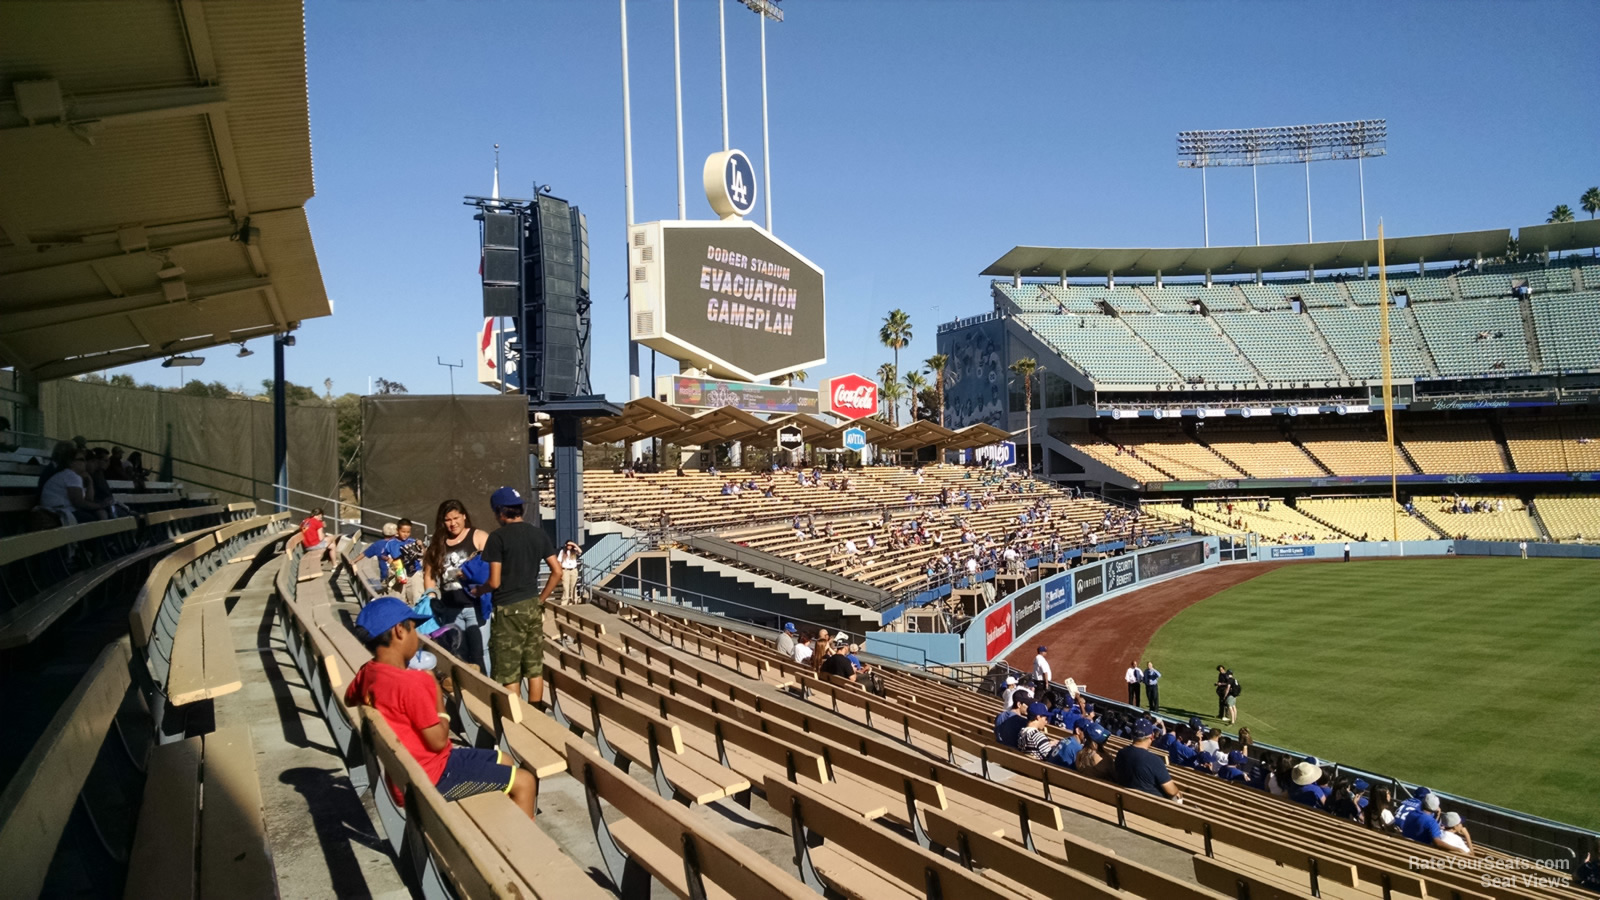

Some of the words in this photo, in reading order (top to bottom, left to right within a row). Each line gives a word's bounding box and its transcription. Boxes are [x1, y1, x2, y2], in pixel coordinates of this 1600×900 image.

[730, 158, 749, 205] LA
[707, 245, 748, 270] DODGER
[750, 257, 791, 281] STADIUM
[699, 264, 798, 311] EVACUATION
[706, 297, 794, 337] GAMEPLAN
[1155, 383, 1220, 391] DODGER
[1232, 382, 1310, 390] STADIUM
[1324, 380, 1367, 388] CLUB
[1446, 400, 1476, 410] Angeles
[1476, 399, 1510, 409] Dodgers
[1116, 559, 1134, 573] SECURITY
[1083, 575, 1102, 589] INFINITI
[1116, 572, 1133, 586] BENEFIT
